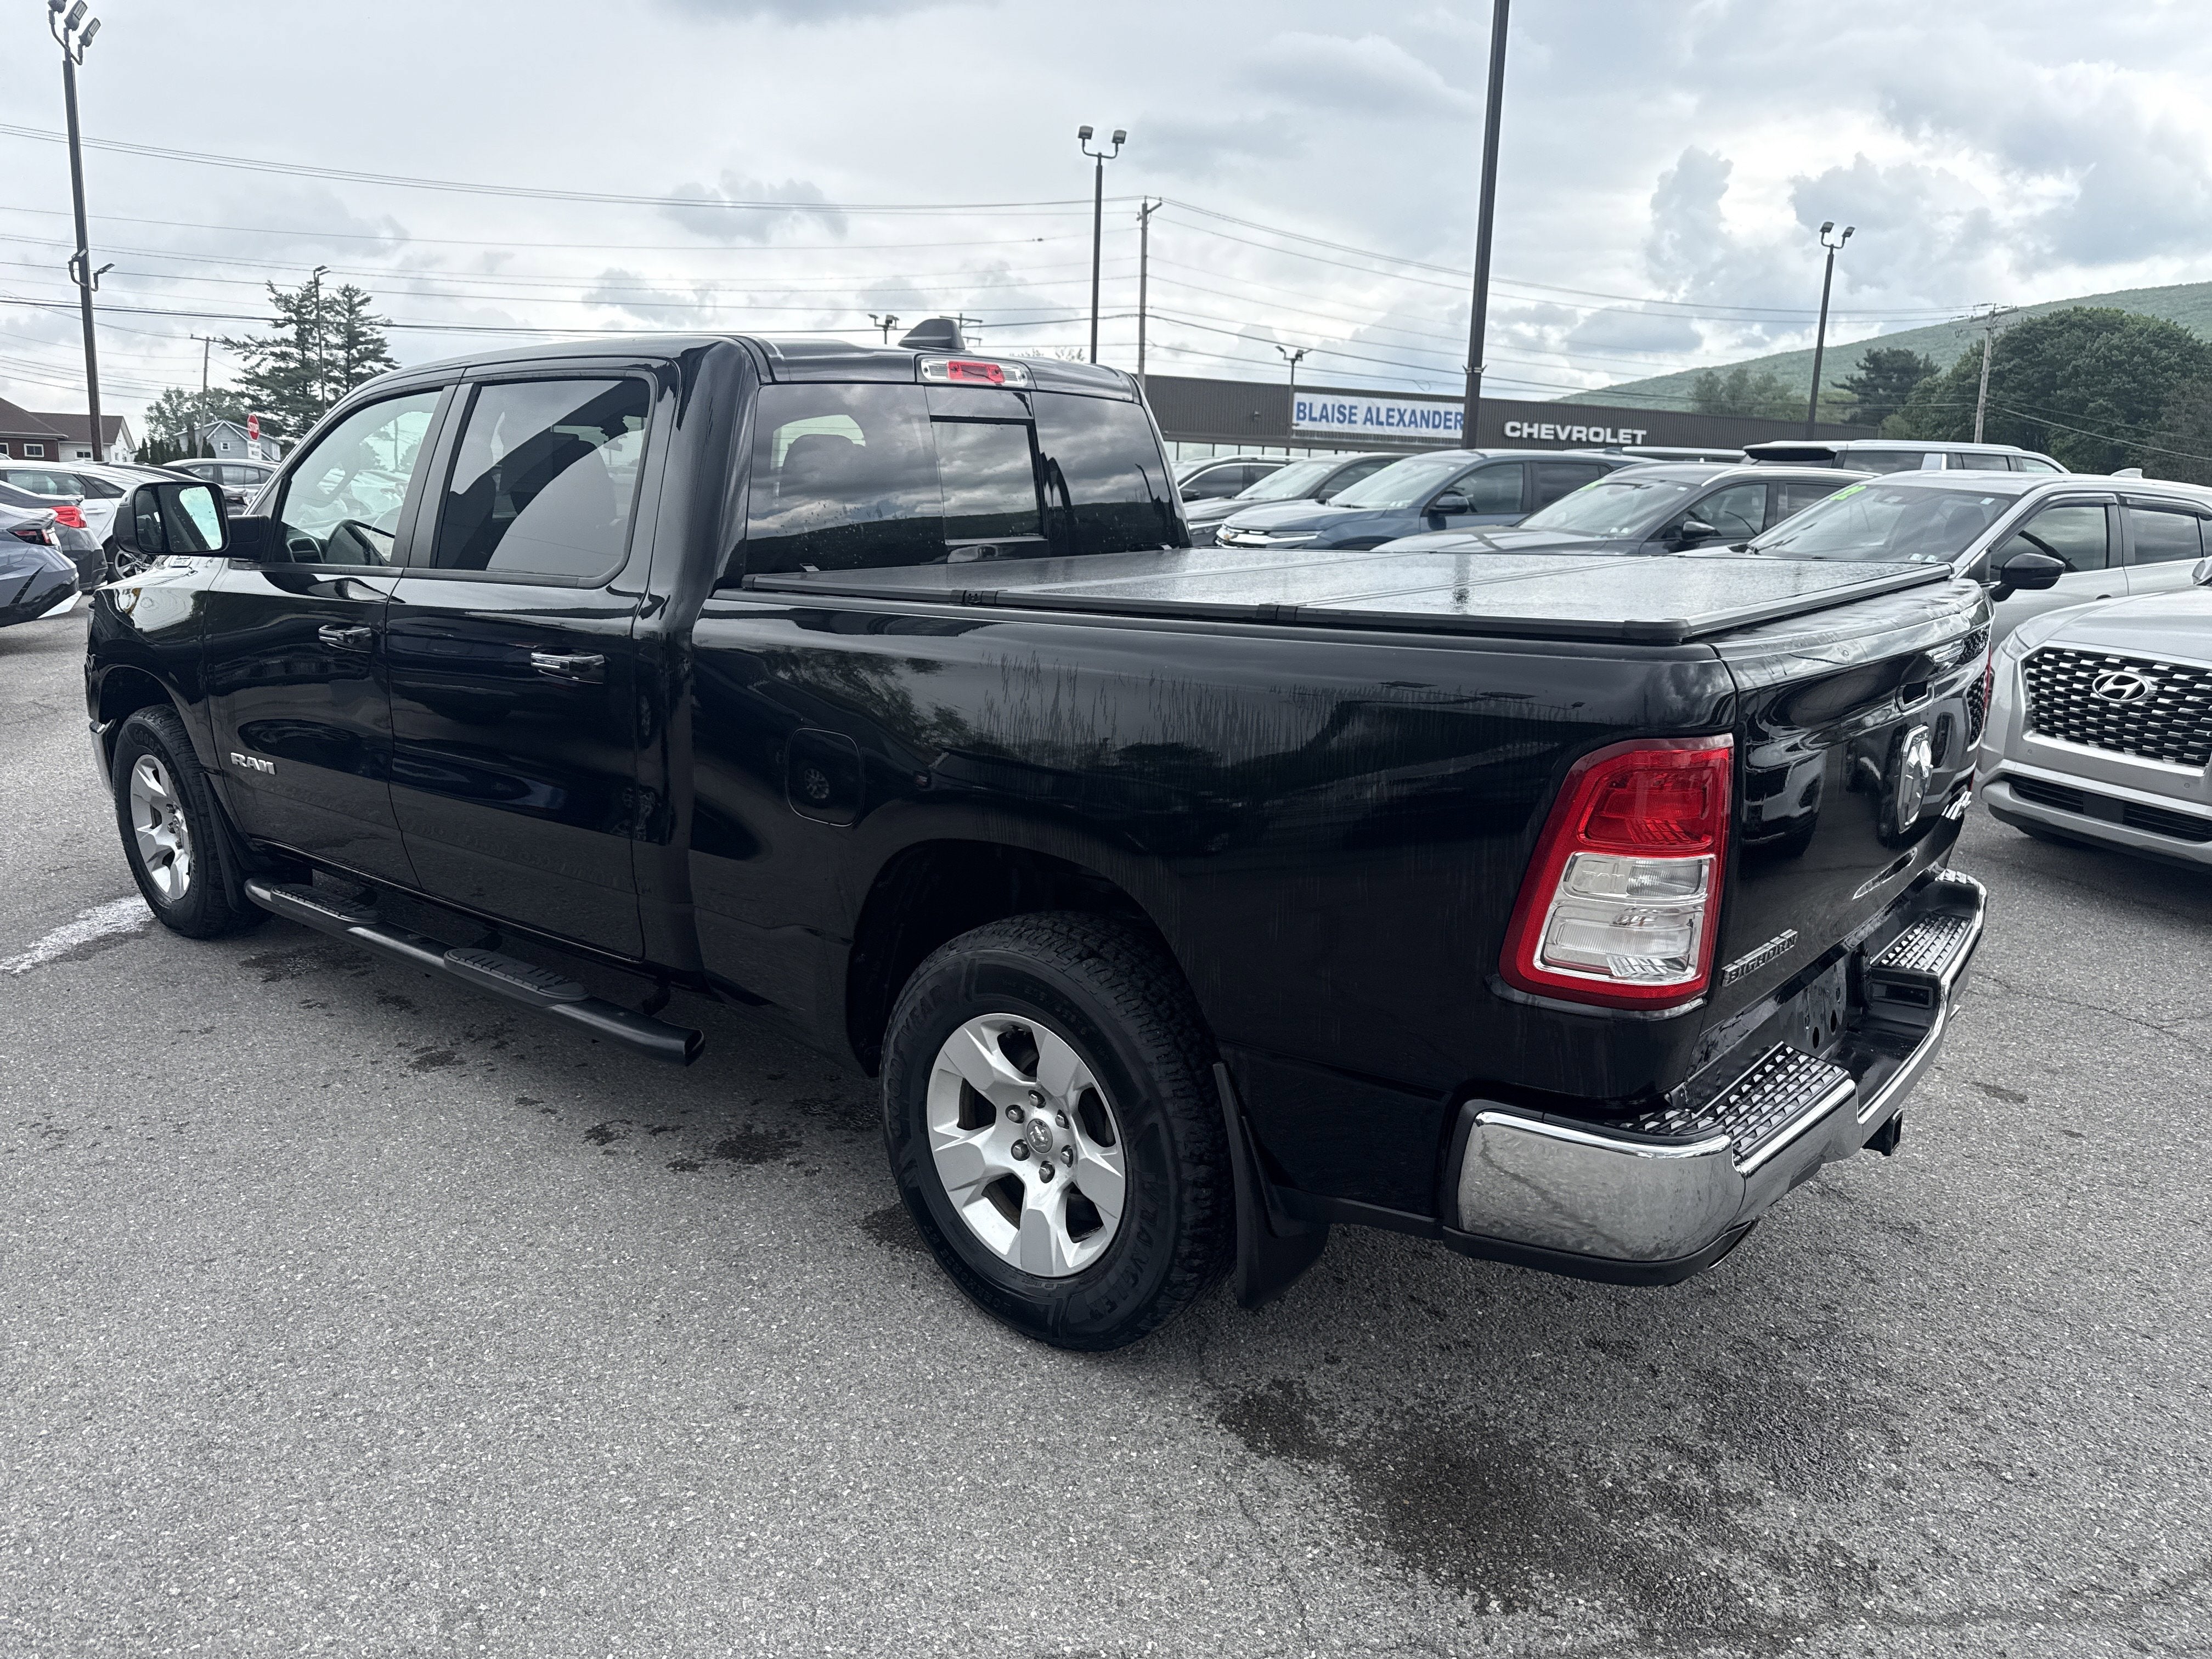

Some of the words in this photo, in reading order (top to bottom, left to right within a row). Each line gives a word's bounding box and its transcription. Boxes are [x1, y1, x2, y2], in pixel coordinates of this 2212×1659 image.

[249, 421, 259, 433] STOP
[1296, 402, 1358, 425] BLAISE
[1362, 406, 1464, 430] ALEXANDER
[1504, 421, 1647, 445] CHEVROLET
[230, 752, 276, 775] RAM
